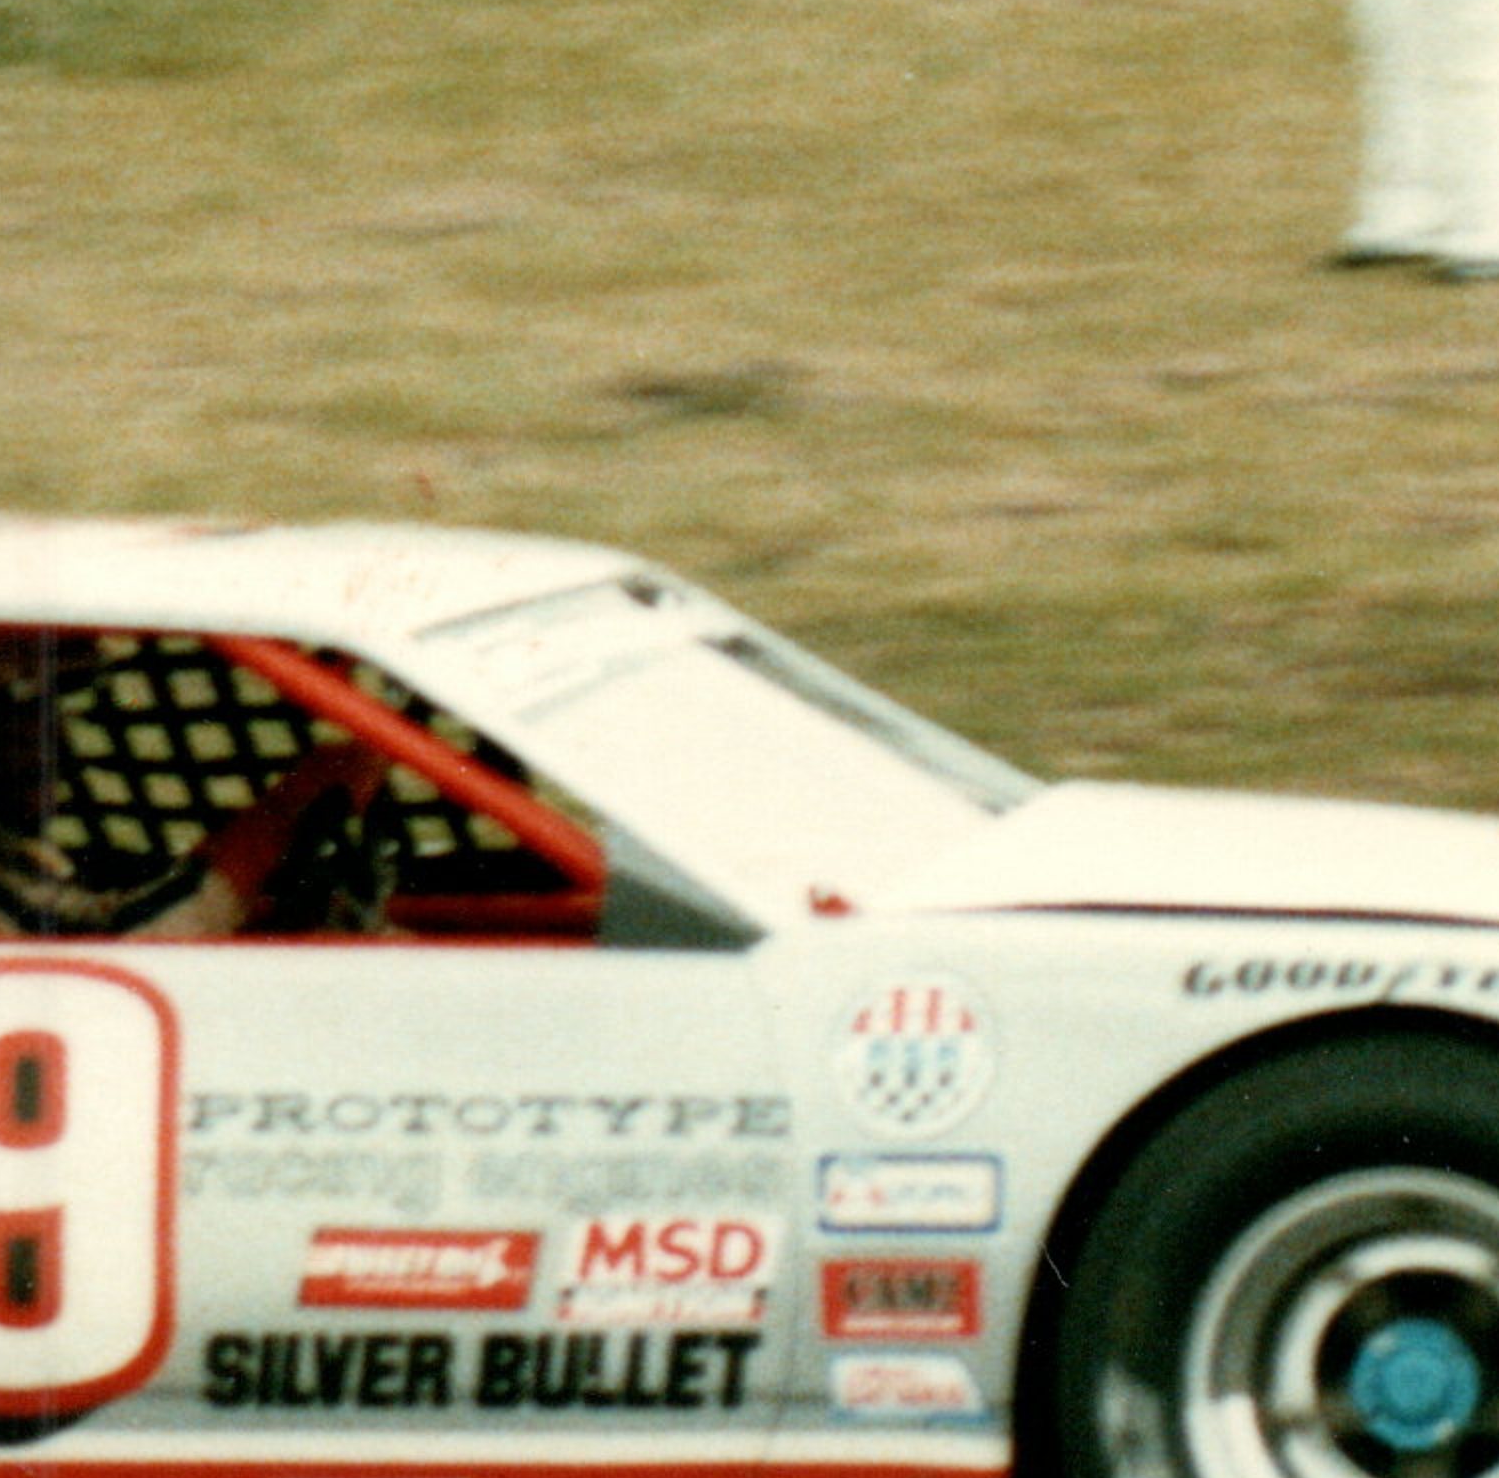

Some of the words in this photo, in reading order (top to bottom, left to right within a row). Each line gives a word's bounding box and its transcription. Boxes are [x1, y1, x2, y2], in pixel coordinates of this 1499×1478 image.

[187, 1093, 792, 1135] PROTOTYPE
[578, 1220, 766, 1283] MSD
[200, 1332, 454, 1409] SILVER
[475, 1330, 764, 1409] BULLET
